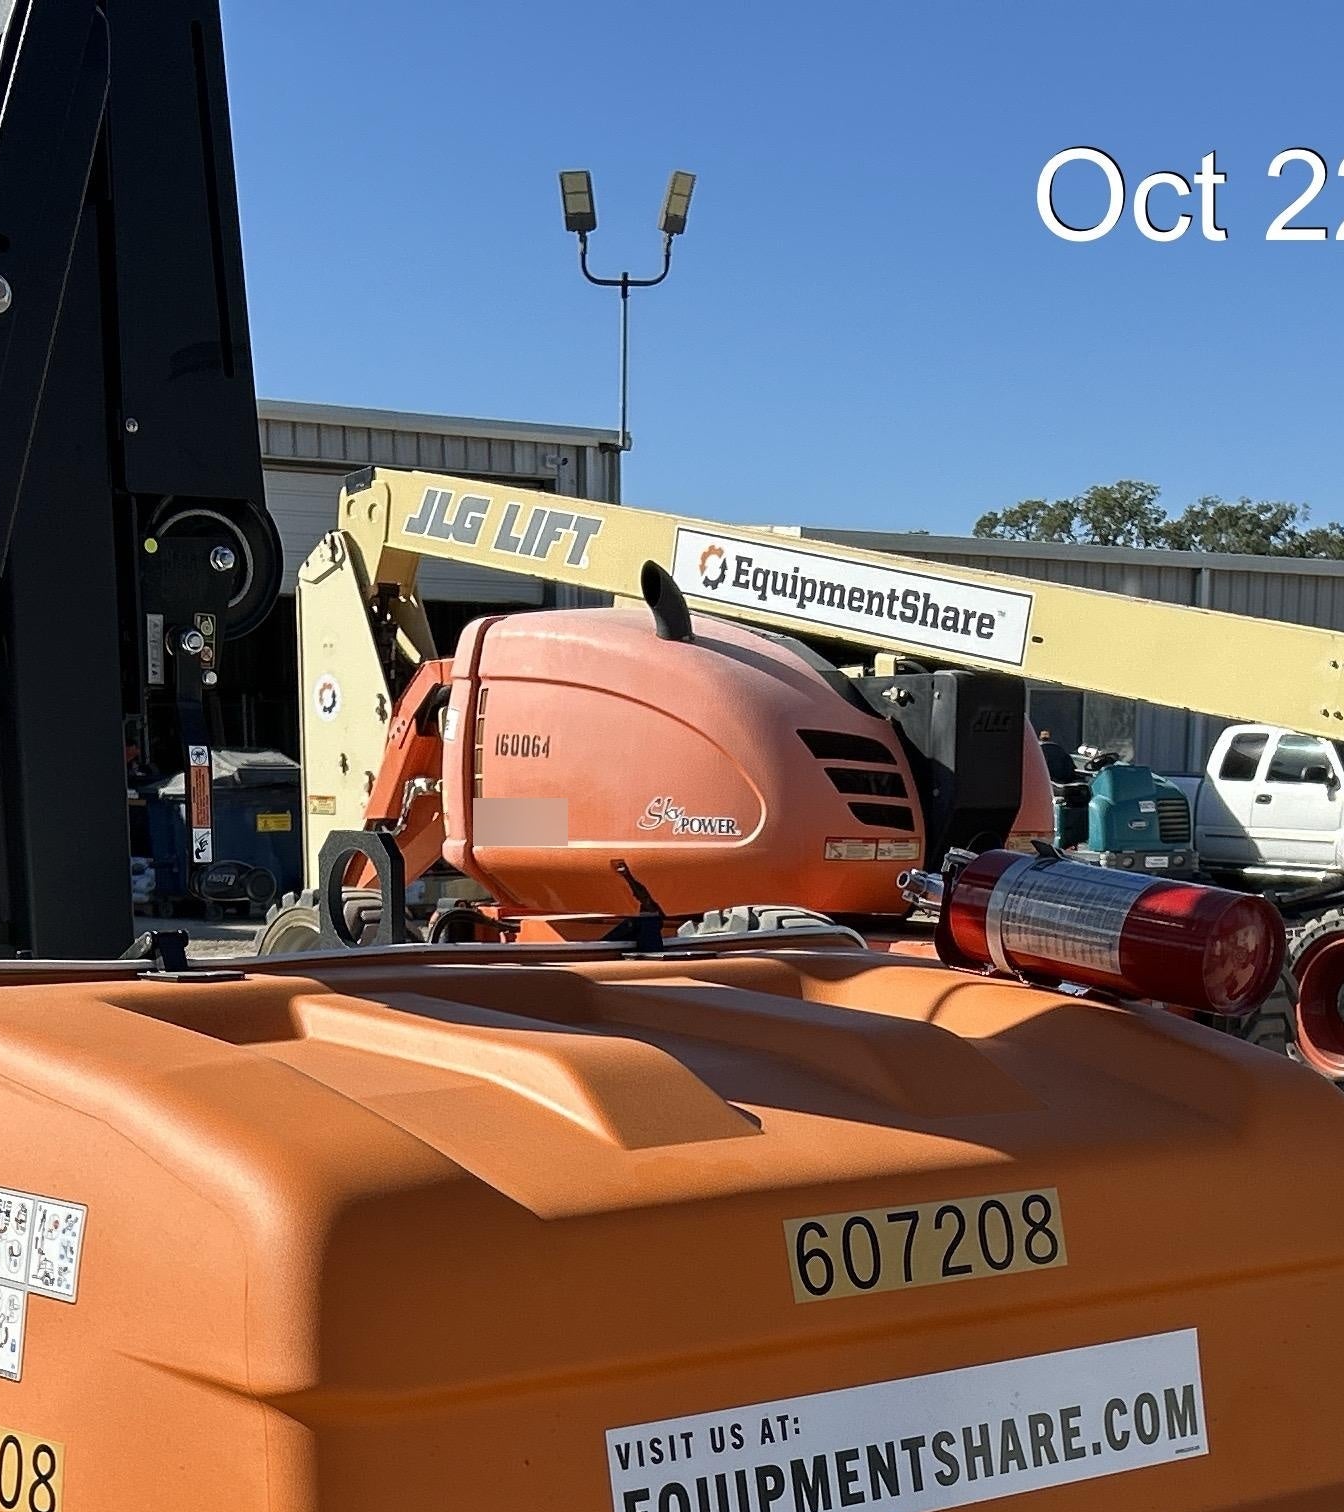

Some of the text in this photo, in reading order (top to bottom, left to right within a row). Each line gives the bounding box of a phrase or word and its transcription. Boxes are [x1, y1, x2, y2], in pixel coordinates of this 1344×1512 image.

[403, 488, 603, 568] JLG LIFT
[733, 554, 998, 640] EquipmentShare
[494, 733, 551, 758] 160064
[681, 817, 738, 835] POWER
[795, 1193, 1058, 1297] 607208
[615, 1414, 800, 1470] VISIT US AT:
